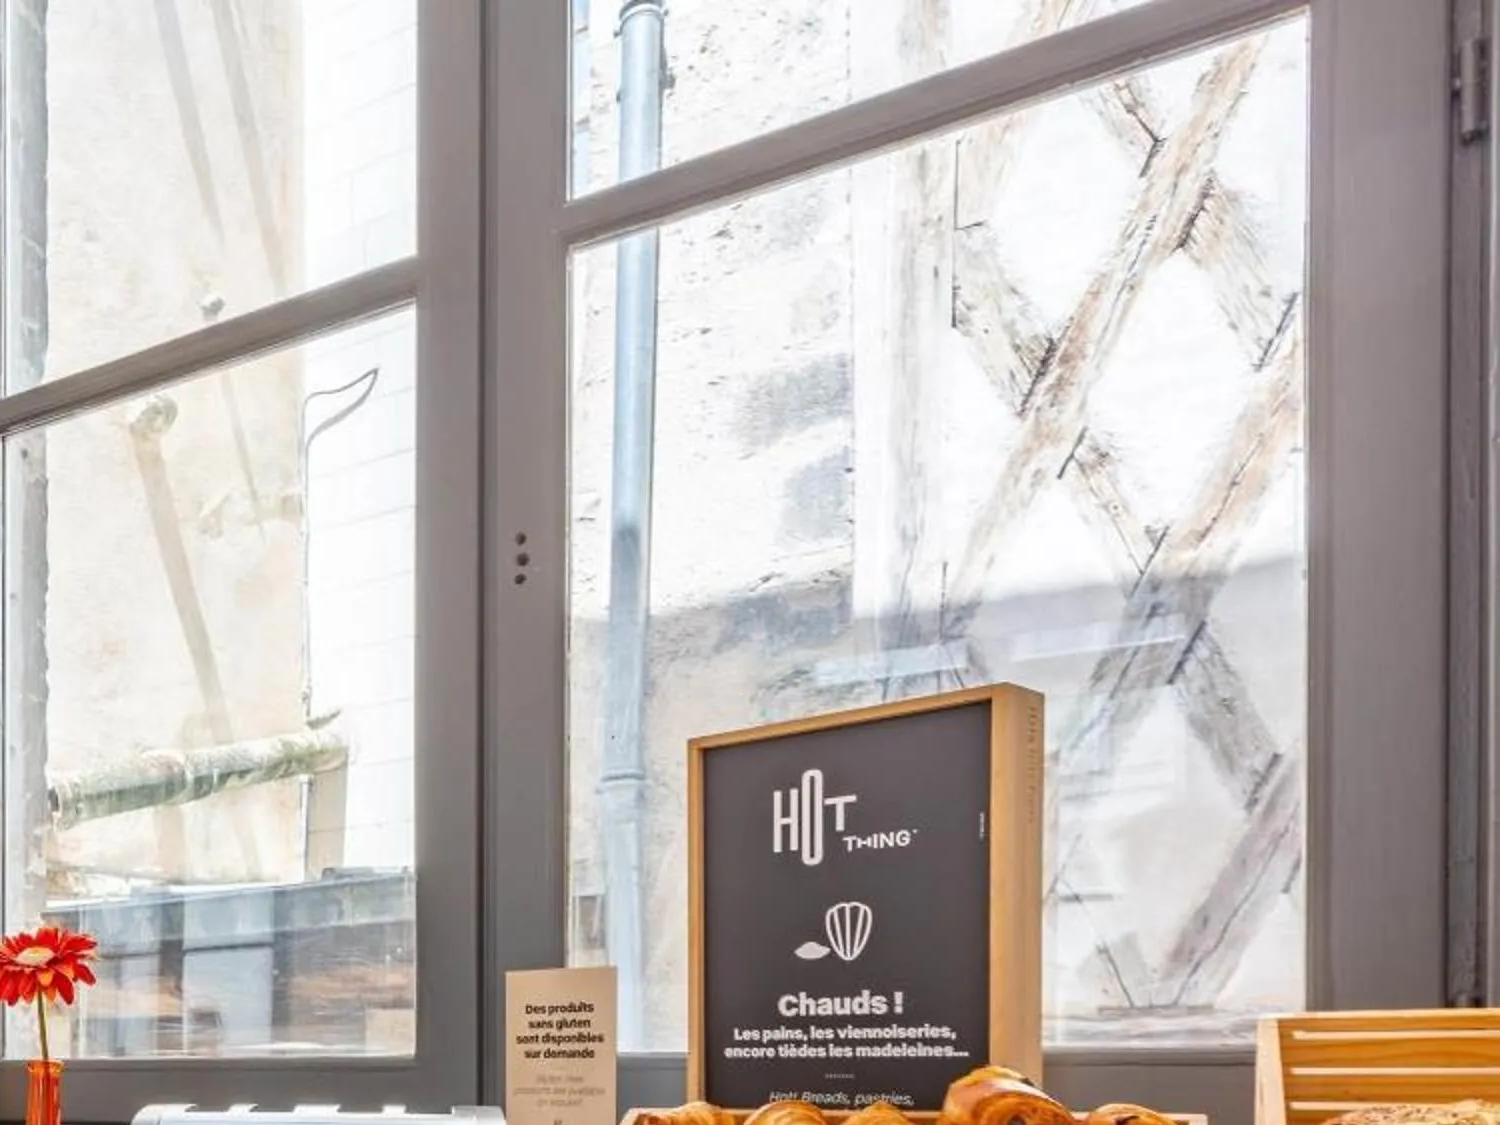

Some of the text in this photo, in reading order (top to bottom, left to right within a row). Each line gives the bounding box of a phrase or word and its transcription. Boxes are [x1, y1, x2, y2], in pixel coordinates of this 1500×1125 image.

[773, 768, 857, 866] HOT
[841, 829, 911, 852] THING
[525, 1001, 594, 1016] Des produits
[777, 989, 904, 1017] Chauds !
[528, 1017, 591, 1031] sans gluten
[516, 1031, 604, 1046] sont disponibles
[733, 1023, 957, 1044] Les pains, les viennoiseries,
[524, 1047, 595, 1059] sur demande
[723, 1042, 969, 1058] encore tièdes les madeleines...
